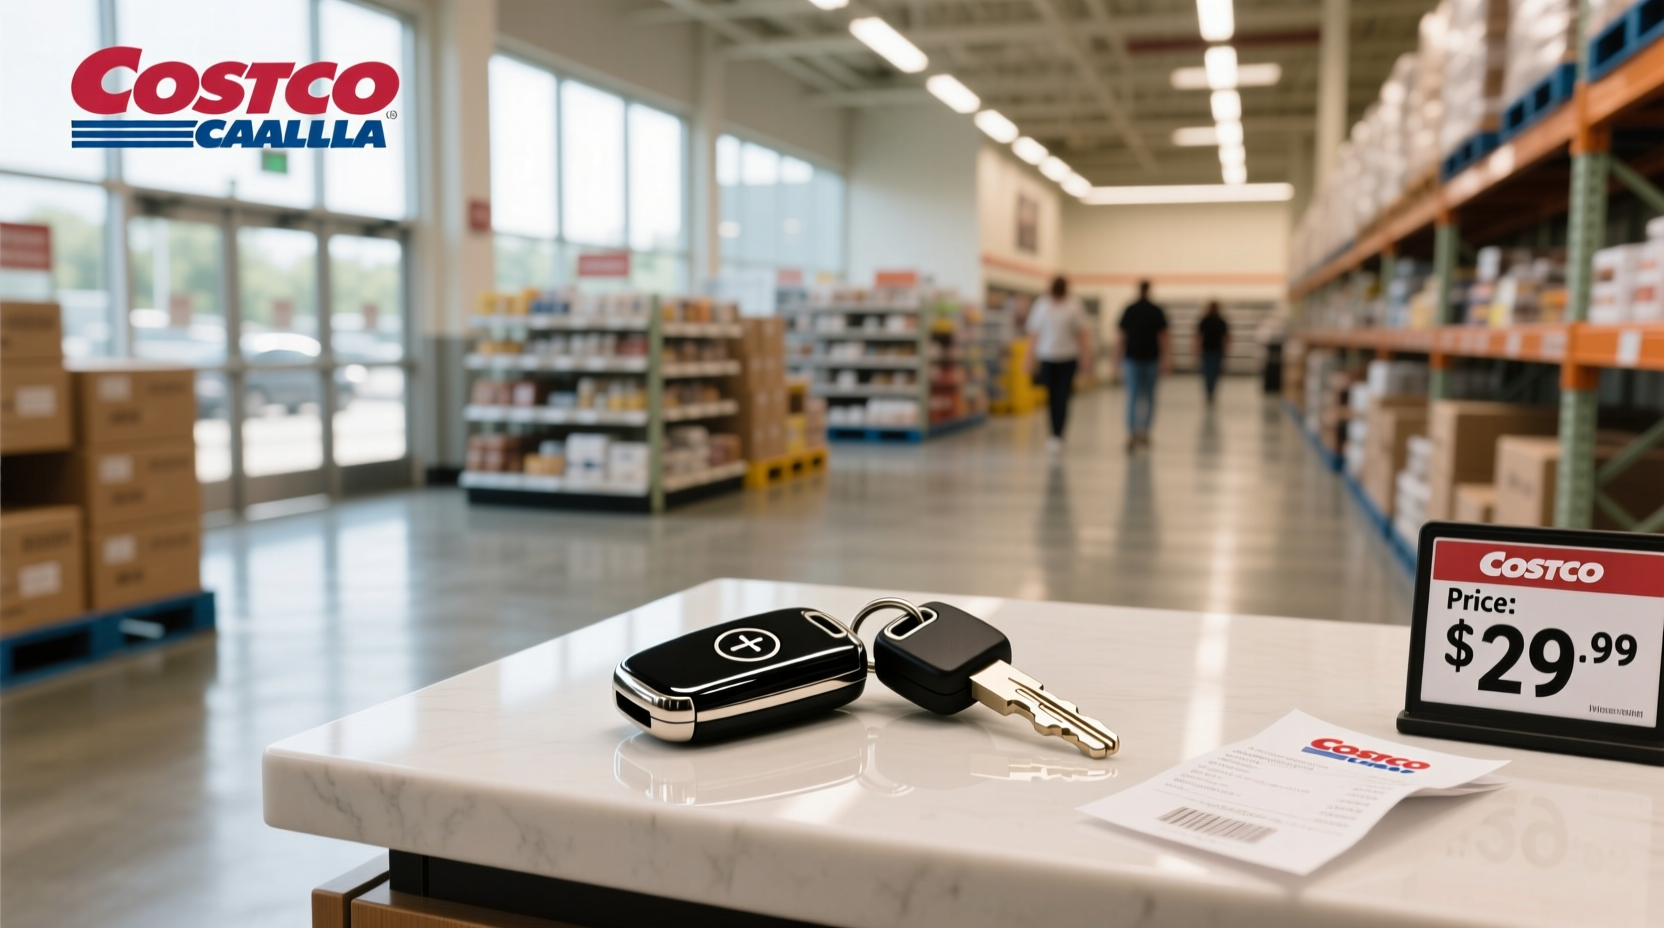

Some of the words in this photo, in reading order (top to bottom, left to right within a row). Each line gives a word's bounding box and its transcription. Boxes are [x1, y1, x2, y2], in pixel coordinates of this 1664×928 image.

[1479, 551, 1605, 584] COSTCO
[1447, 587, 1516, 615] Price:
[1310, 738, 1431, 770] COSTCO
